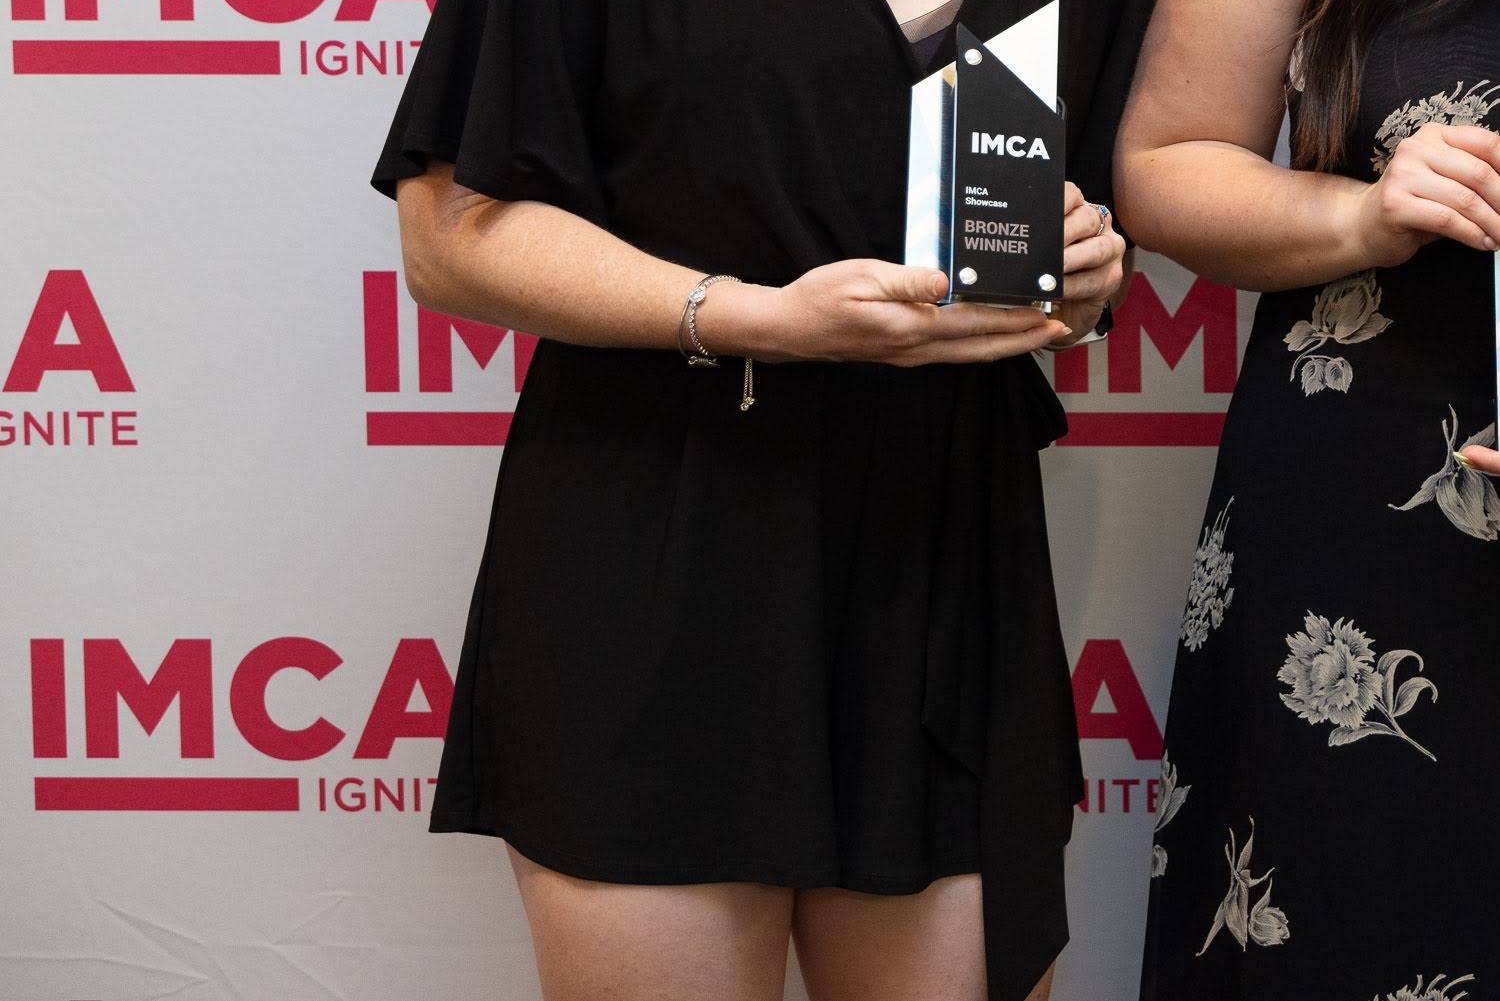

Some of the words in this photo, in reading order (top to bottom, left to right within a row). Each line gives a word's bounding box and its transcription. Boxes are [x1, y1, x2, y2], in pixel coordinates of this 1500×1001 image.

[301, 40, 424, 75] IGNI
[970, 131, 1051, 160] IMCA
[965, 185, 989, 197] IMCA
[965, 196, 1008, 209] Showcase
[964, 219, 1030, 238] BRONZE
[964, 236, 1029, 255] WINNER
[0, 411, 138, 446] GNITE
[30, 637, 455, 760] IMCA
[319, 777, 438, 812] IGNI
